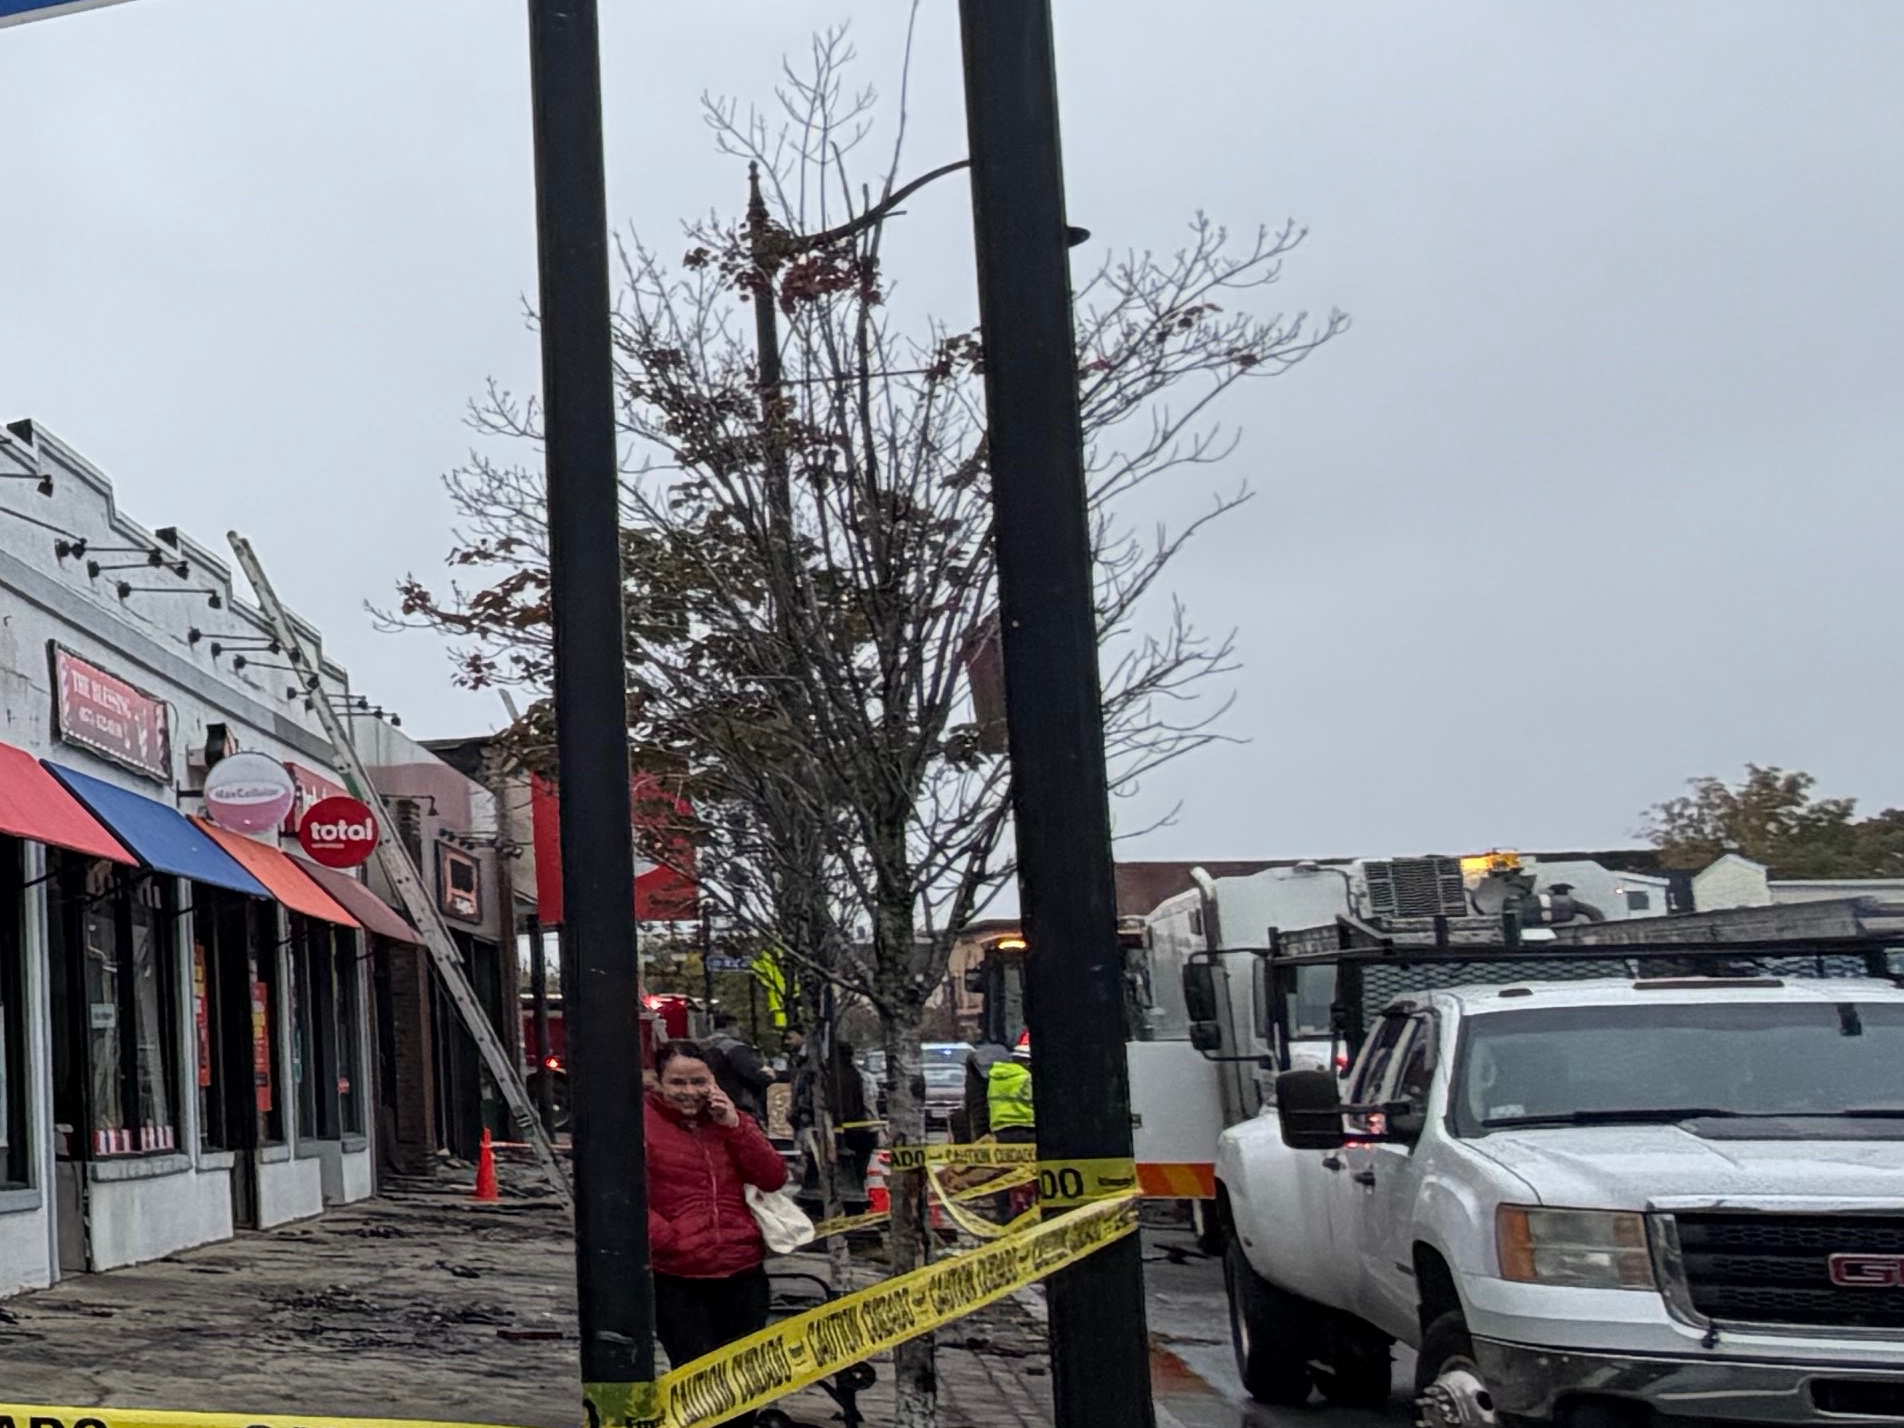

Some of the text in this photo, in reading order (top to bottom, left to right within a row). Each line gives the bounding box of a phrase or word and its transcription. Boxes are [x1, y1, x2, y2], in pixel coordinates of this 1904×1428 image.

[309, 817, 374, 842] total
[730, 1333, 793, 1404] CUIDADO
[806, 1305, 865, 1368] CAUTION
[861, 1286, 916, 1344] CUIDADO
